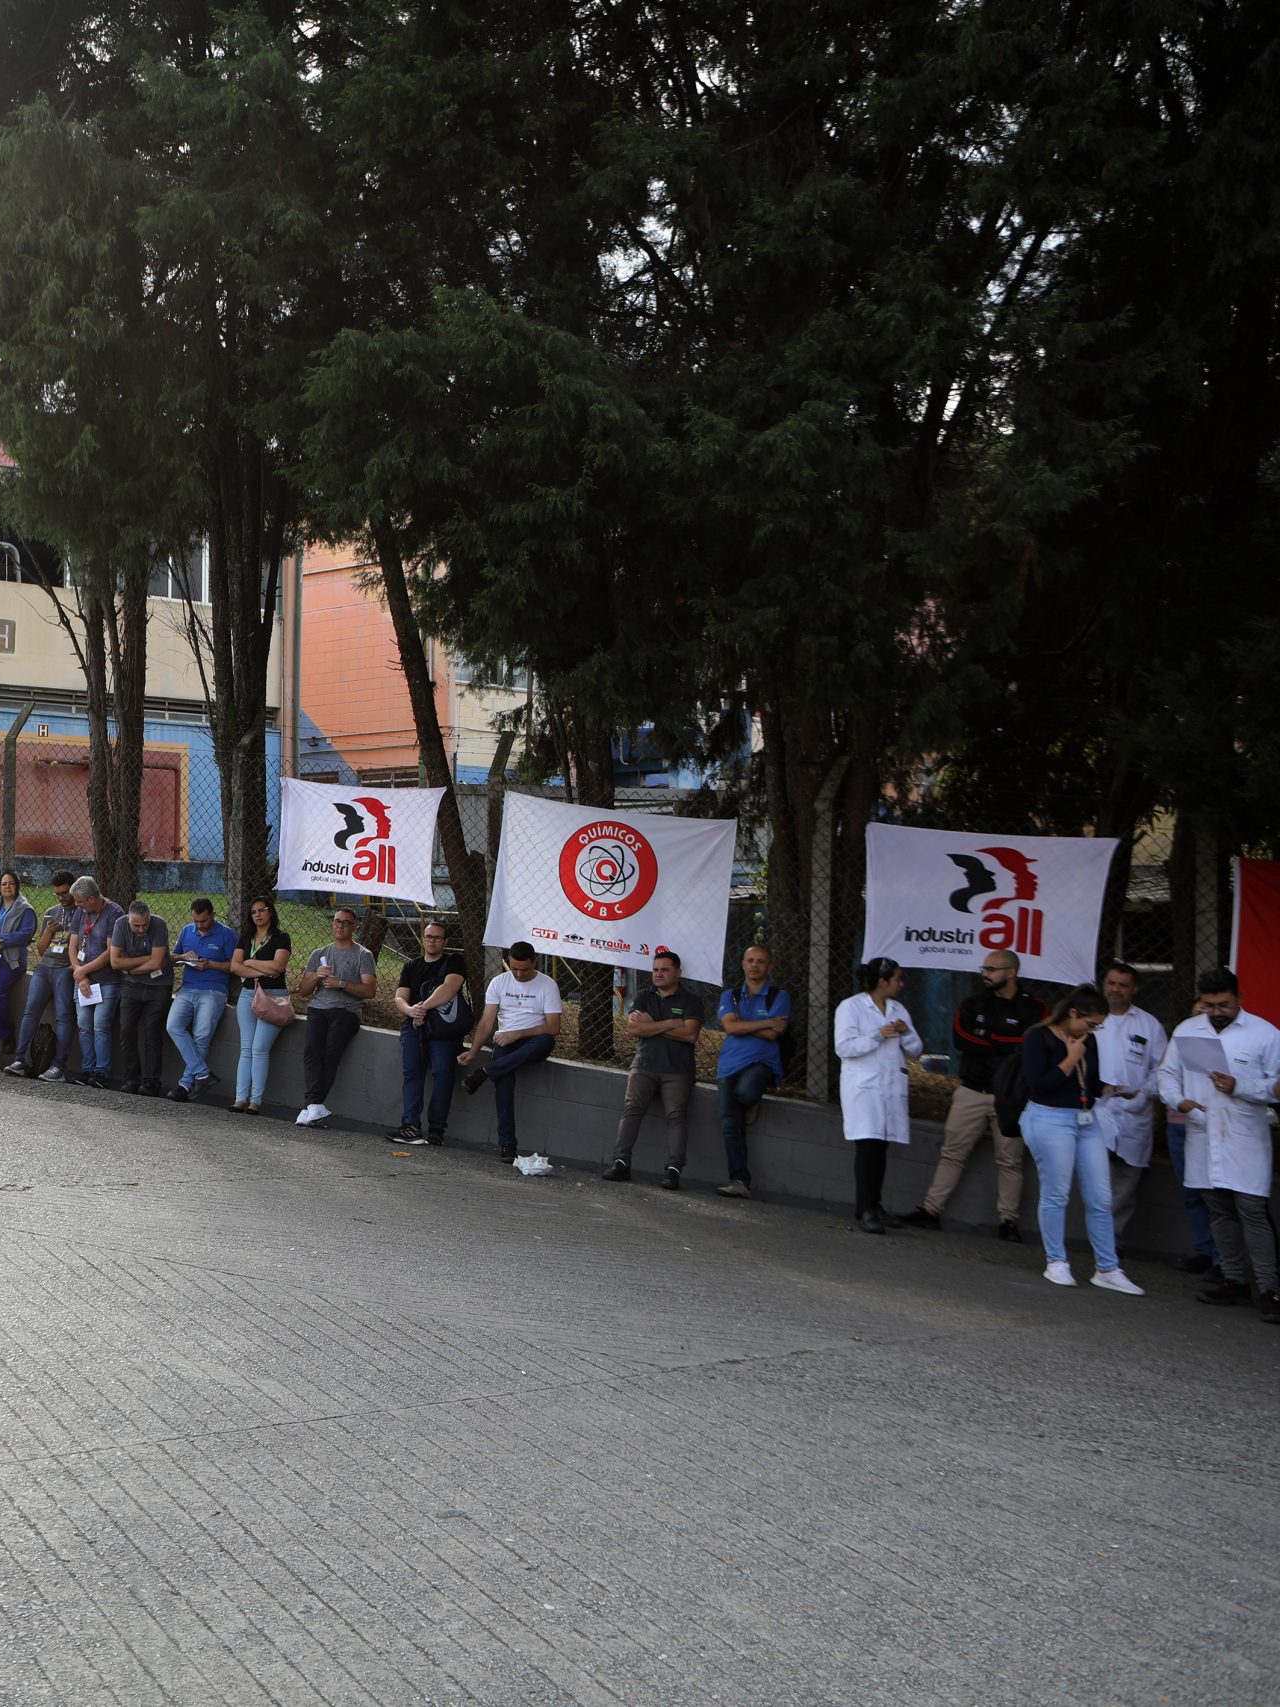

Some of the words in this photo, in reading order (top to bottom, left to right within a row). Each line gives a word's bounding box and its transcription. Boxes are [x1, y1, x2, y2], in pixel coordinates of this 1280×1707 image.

[39, 725, 48, 737] H
[578, 823, 643, 852] QUÍMICOS
[301, 859, 349, 876] industri
[351, 844, 396, 885] all
[310, 874, 330, 885] global
[330, 877, 348, 885] union
[532, 928, 556, 940] CUT
[904, 926, 975, 945] industri
[978, 906, 1044, 957] all
[919, 945, 946, 955] global
[948, 946, 973, 956] union
